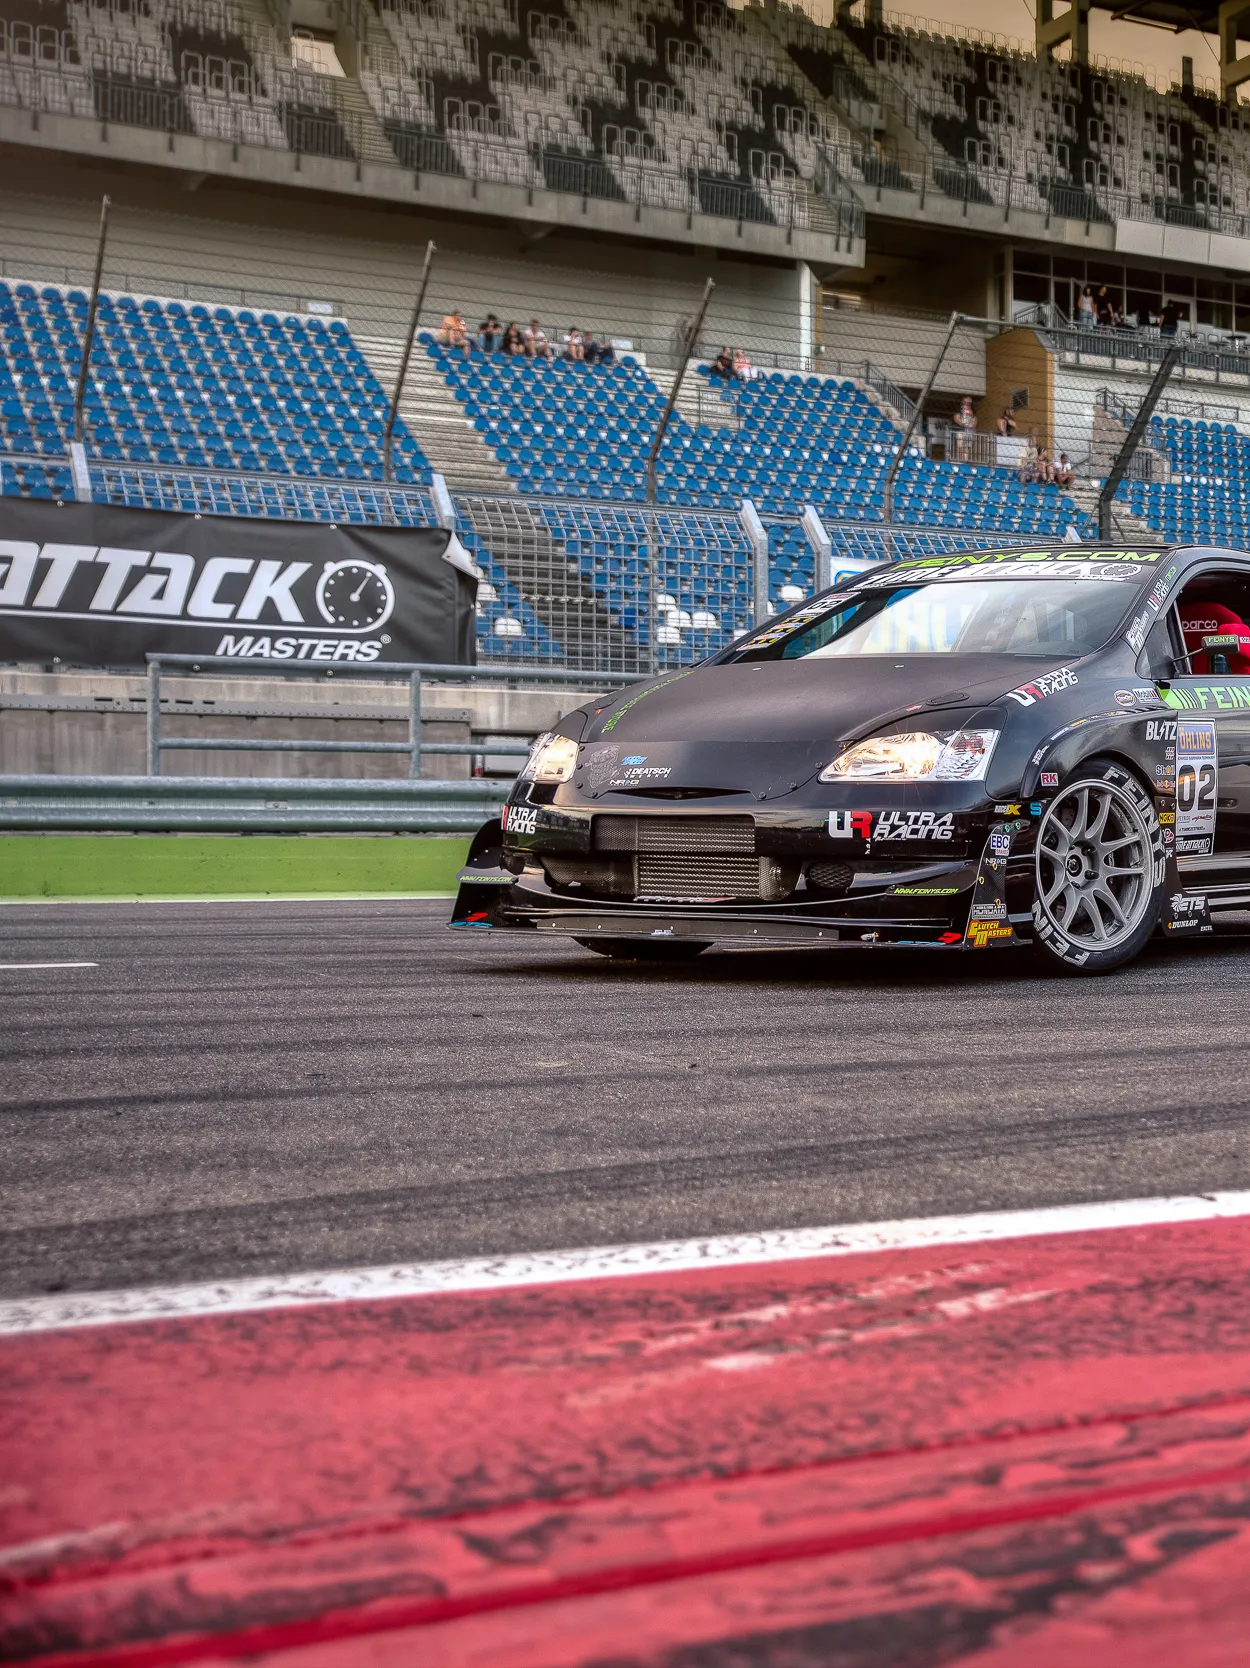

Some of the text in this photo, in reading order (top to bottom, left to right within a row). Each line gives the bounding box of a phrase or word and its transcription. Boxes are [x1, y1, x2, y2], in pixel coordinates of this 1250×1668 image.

[891, 551, 1162, 571] FEINYS.COM
[807, 599, 843, 611] 02
[1180, 619, 1218, 632] parco
[1040, 671, 1079, 698] RACING
[1146, 720, 1178, 741] BLITZ
[1180, 727, 1213, 750] ÖHLINS
[632, 767, 672, 775] DEATSCH
[1042, 773, 1057, 784] RK
[1178, 764, 1216, 812] 02
[508, 806, 538, 821] ULTRA
[878, 811, 954, 826] ULTRA
[506, 820, 538, 834] RACING
[828, 810, 873, 838] UR
[872, 825, 956, 840] RACING
[991, 835, 1009, 849] EBC
[969, 922, 999, 936] CLUTCH
[1172, 919, 1199, 929] DUNLOP
[976, 929, 1011, 945] MASTERS
